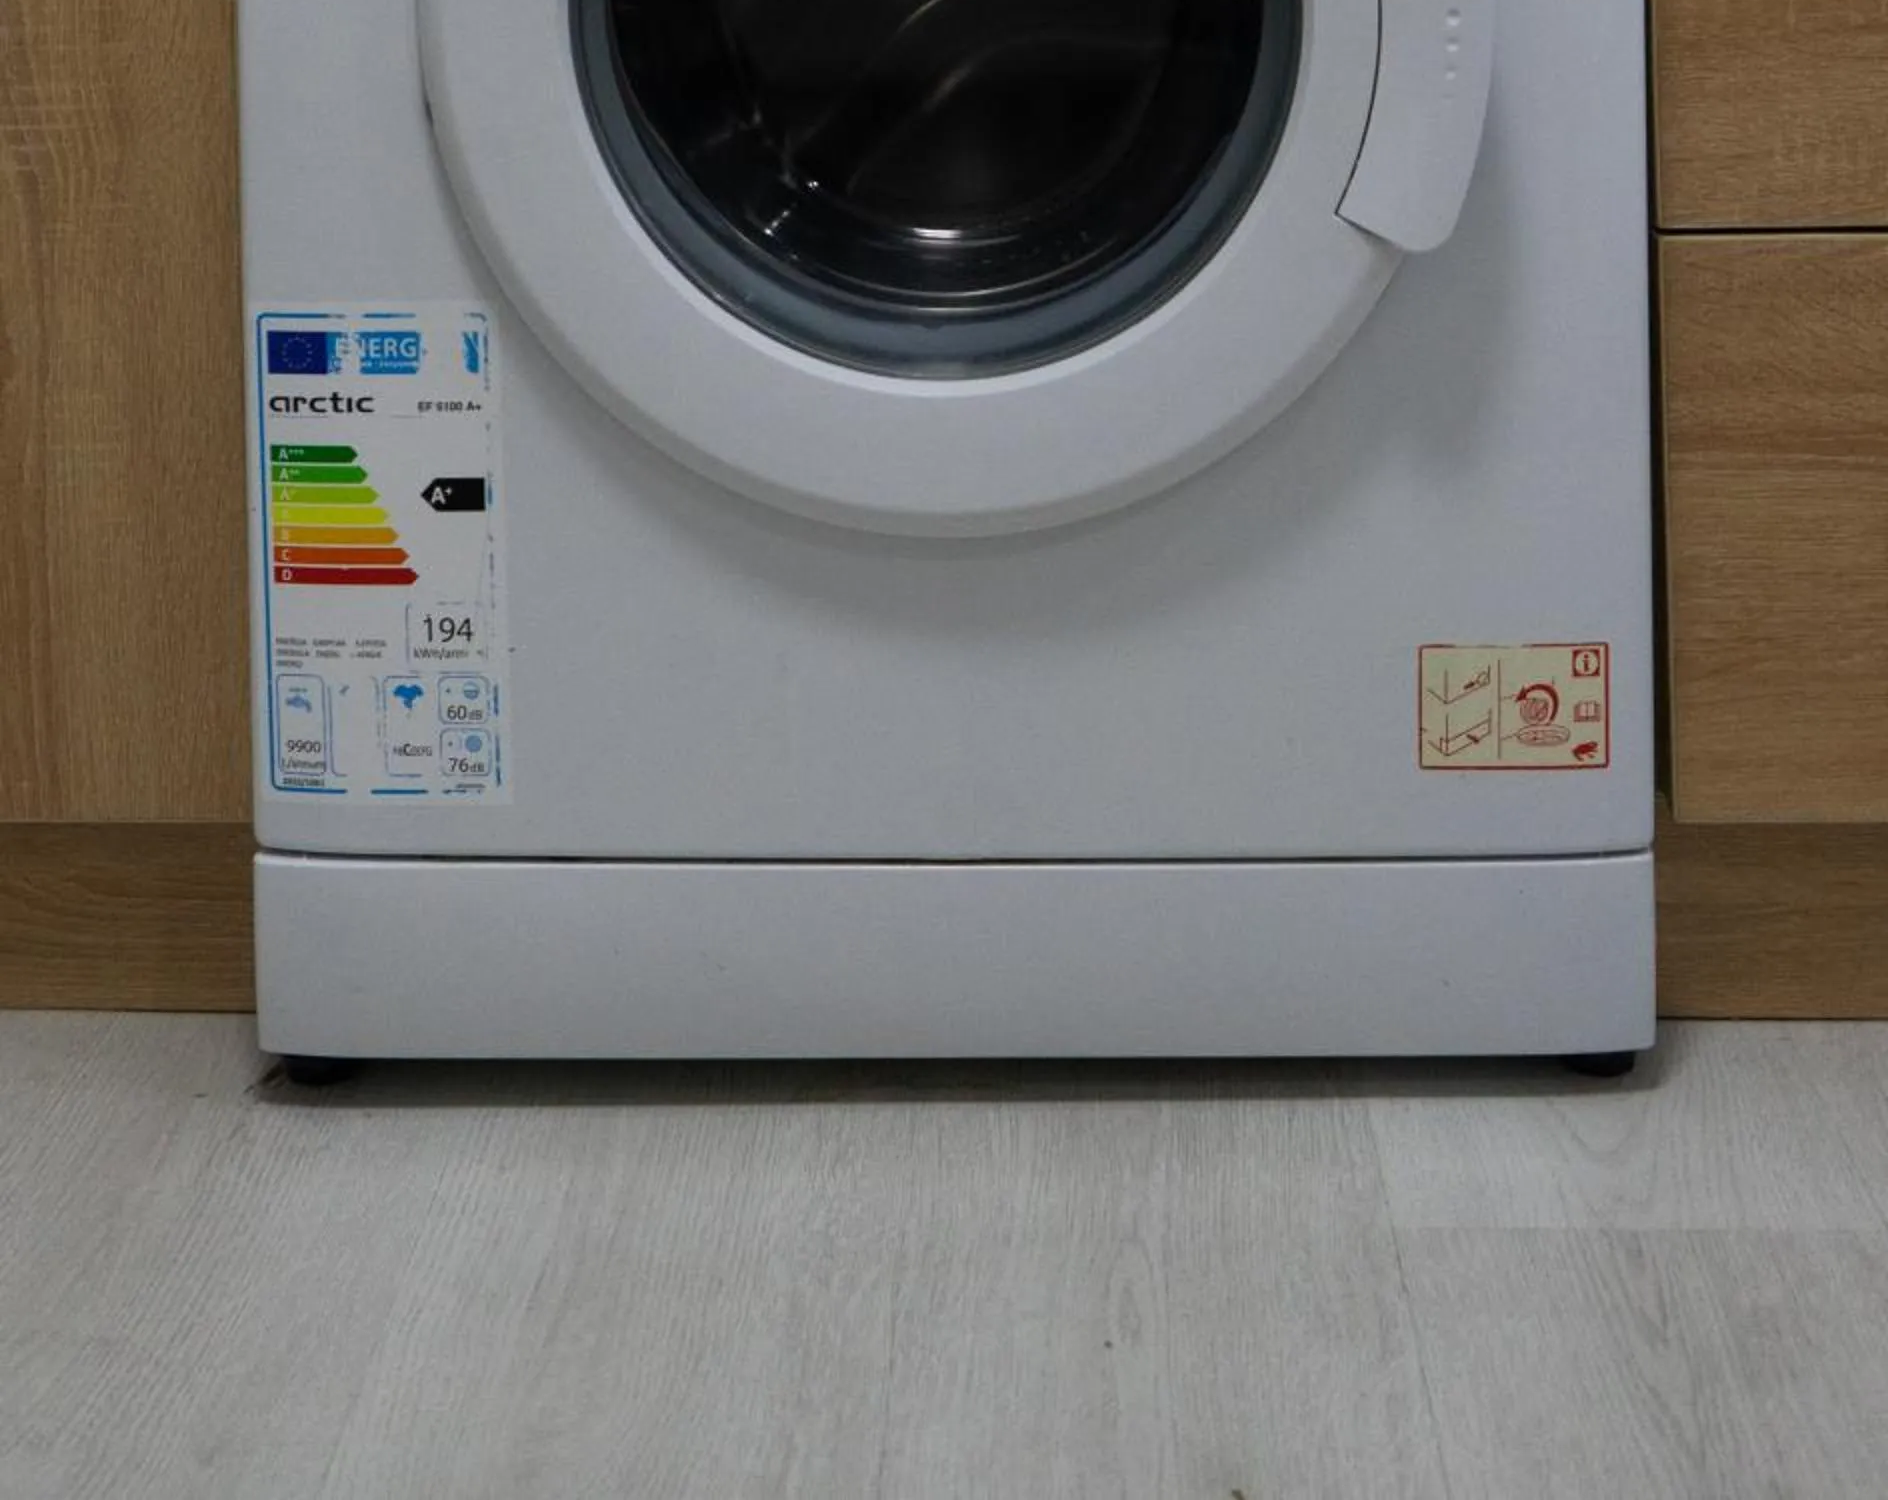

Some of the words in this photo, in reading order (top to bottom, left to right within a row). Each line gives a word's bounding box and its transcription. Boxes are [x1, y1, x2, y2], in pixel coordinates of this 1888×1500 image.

[269, 391, 374, 413] arctic
[418, 401, 433, 412] EF
[465, 401, 482, 412] A+
[430, 486, 453, 505] A+
[281, 568, 293, 581] D
[423, 613, 474, 643] 194
[286, 739, 322, 753] 9900
